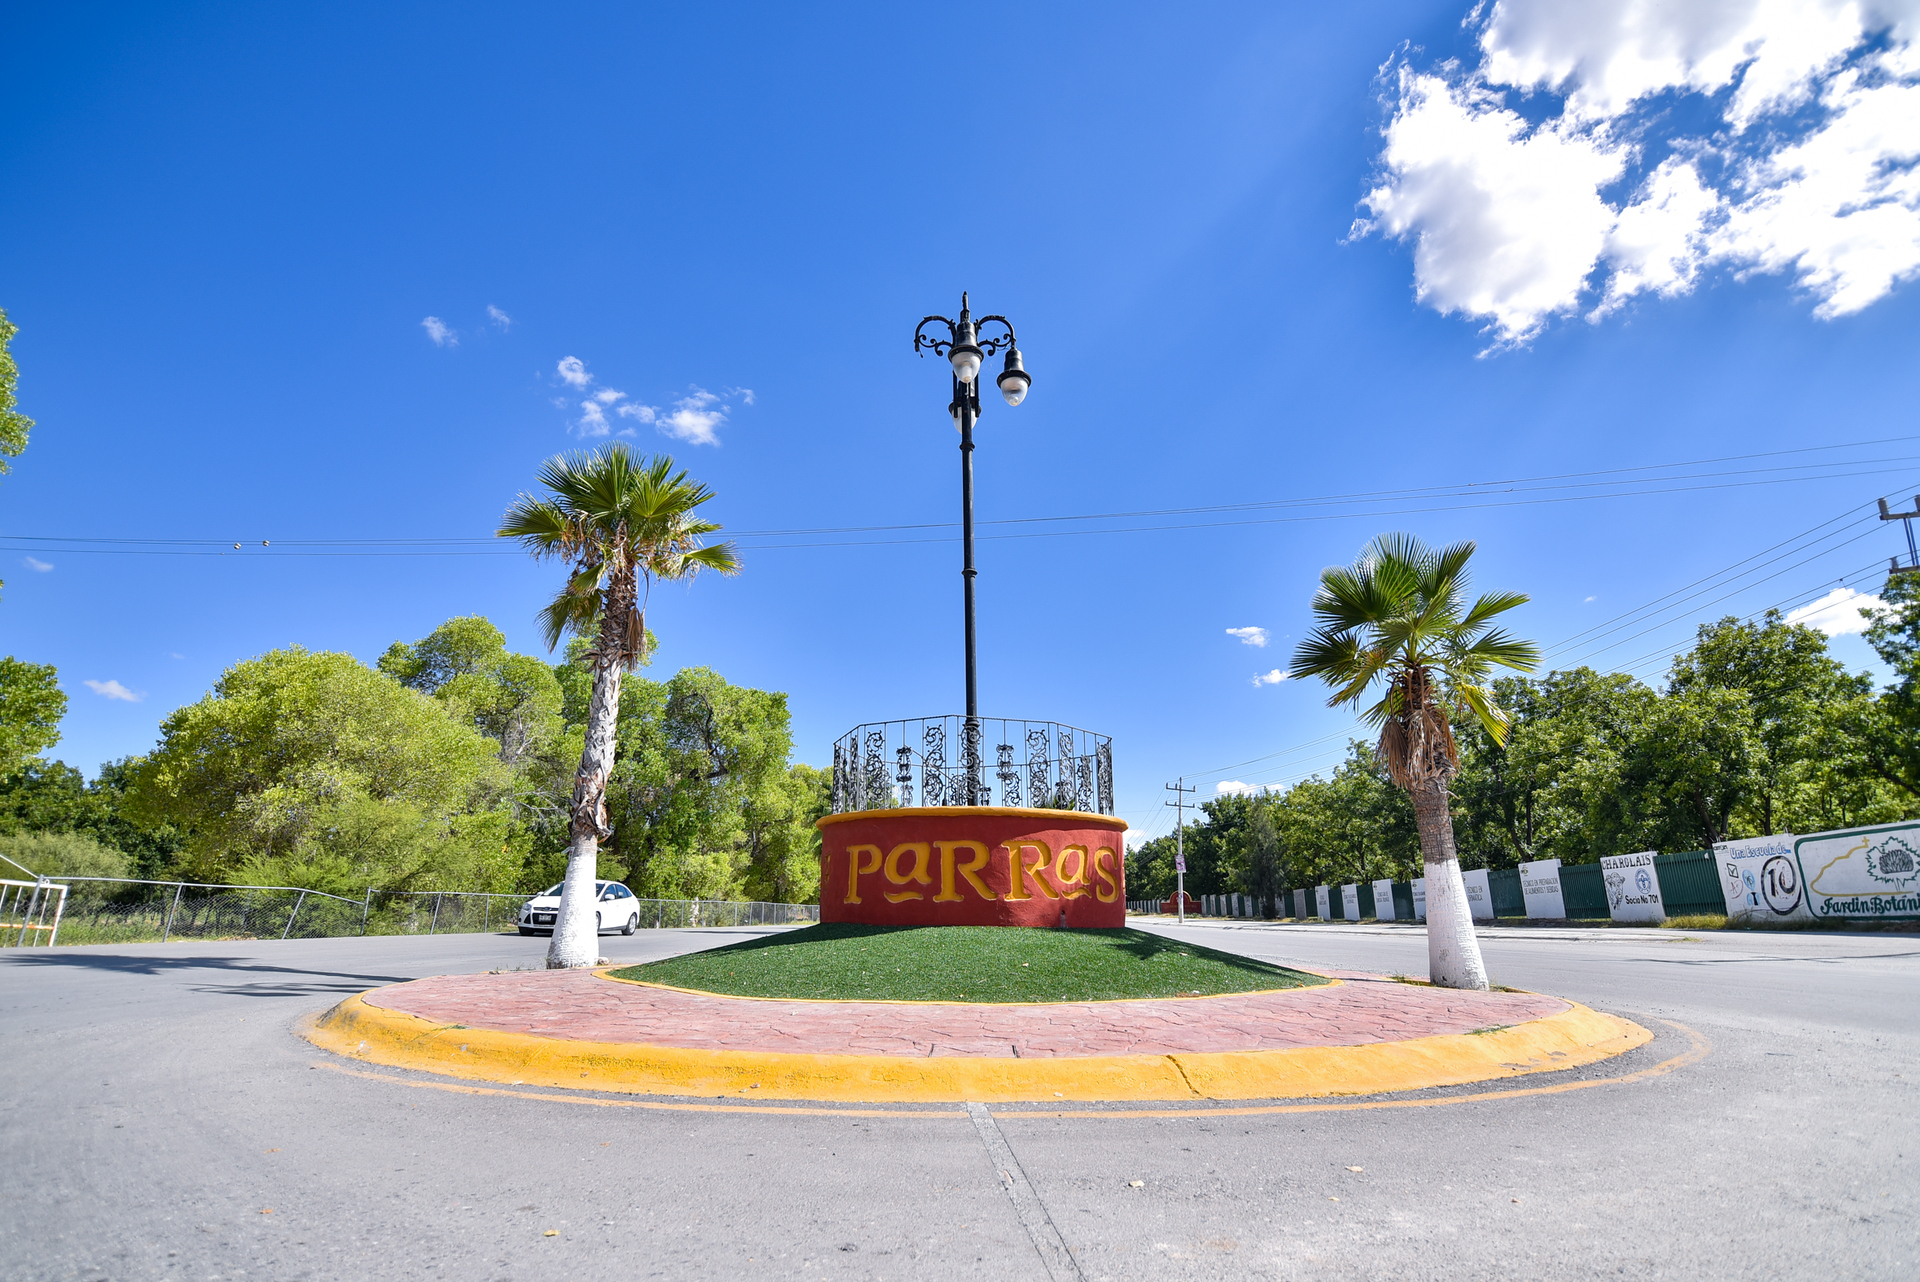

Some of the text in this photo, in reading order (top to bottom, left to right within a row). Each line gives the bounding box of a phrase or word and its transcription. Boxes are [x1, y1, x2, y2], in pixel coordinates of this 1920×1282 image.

[1730, 847, 1746, 860] Una
[1745, 843, 1775, 858] Escuela
[1625, 894, 1641, 905] Socio
[1648, 894, 1660, 904] 701
